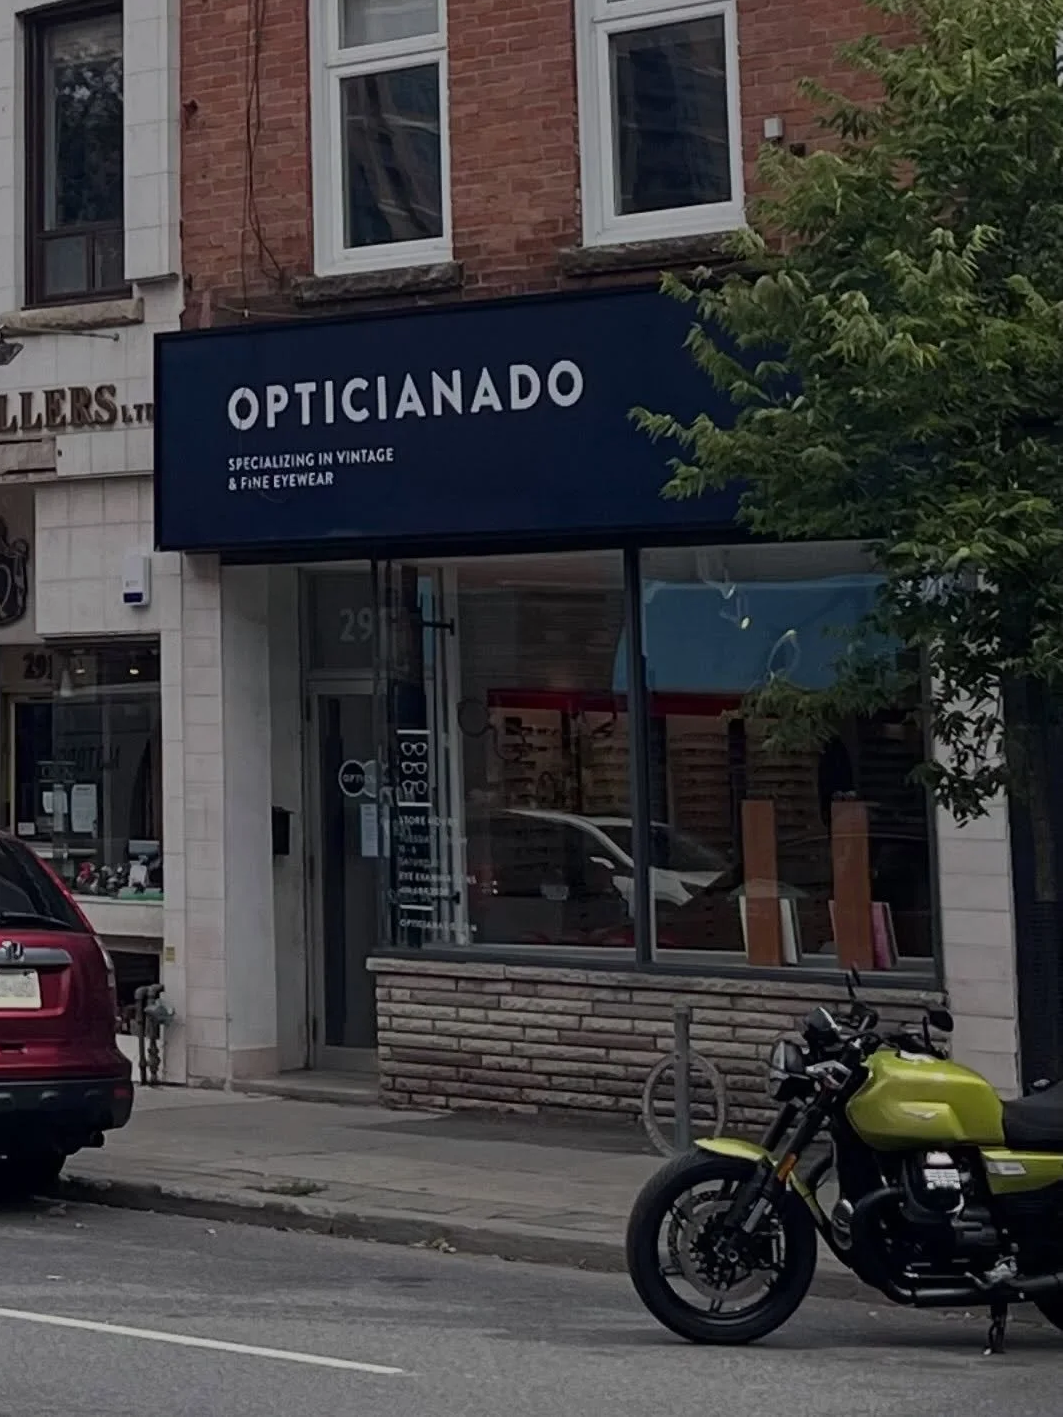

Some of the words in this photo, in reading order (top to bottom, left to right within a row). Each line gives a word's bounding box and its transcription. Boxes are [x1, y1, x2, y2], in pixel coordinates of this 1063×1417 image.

[227, 359, 584, 432] OPTICIANADO
[227, 452, 315, 472] SPECIALIZING
[318, 451, 333, 466] IN
[336, 447, 395, 465] VINTAGE
[227, 477, 238, 491] &
[240, 475, 270, 490] FINE
[273, 472, 334, 489] EYEWEAR
